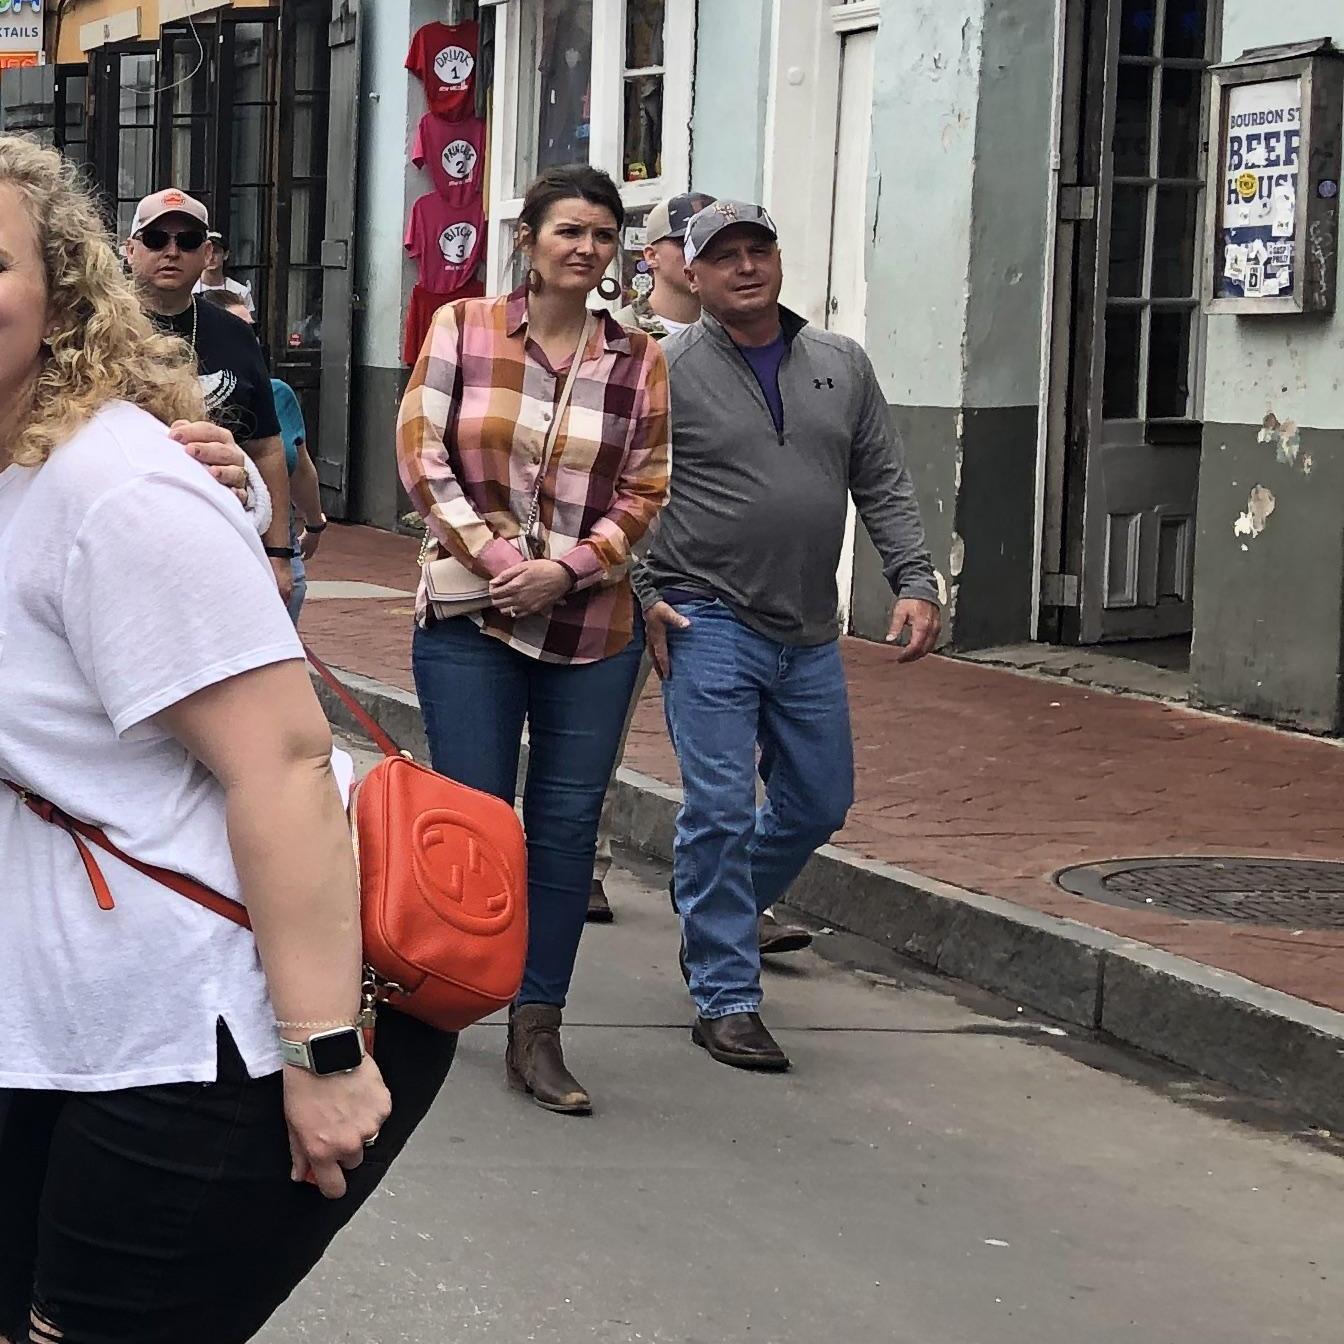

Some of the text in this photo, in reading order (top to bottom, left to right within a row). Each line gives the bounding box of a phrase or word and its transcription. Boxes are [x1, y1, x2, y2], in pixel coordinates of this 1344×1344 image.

[450, 65, 460, 80] 1
[1230, 109, 1285, 130] BOURBON
[455, 160, 465, 174] 2
[455, 244, 465, 258] 3
